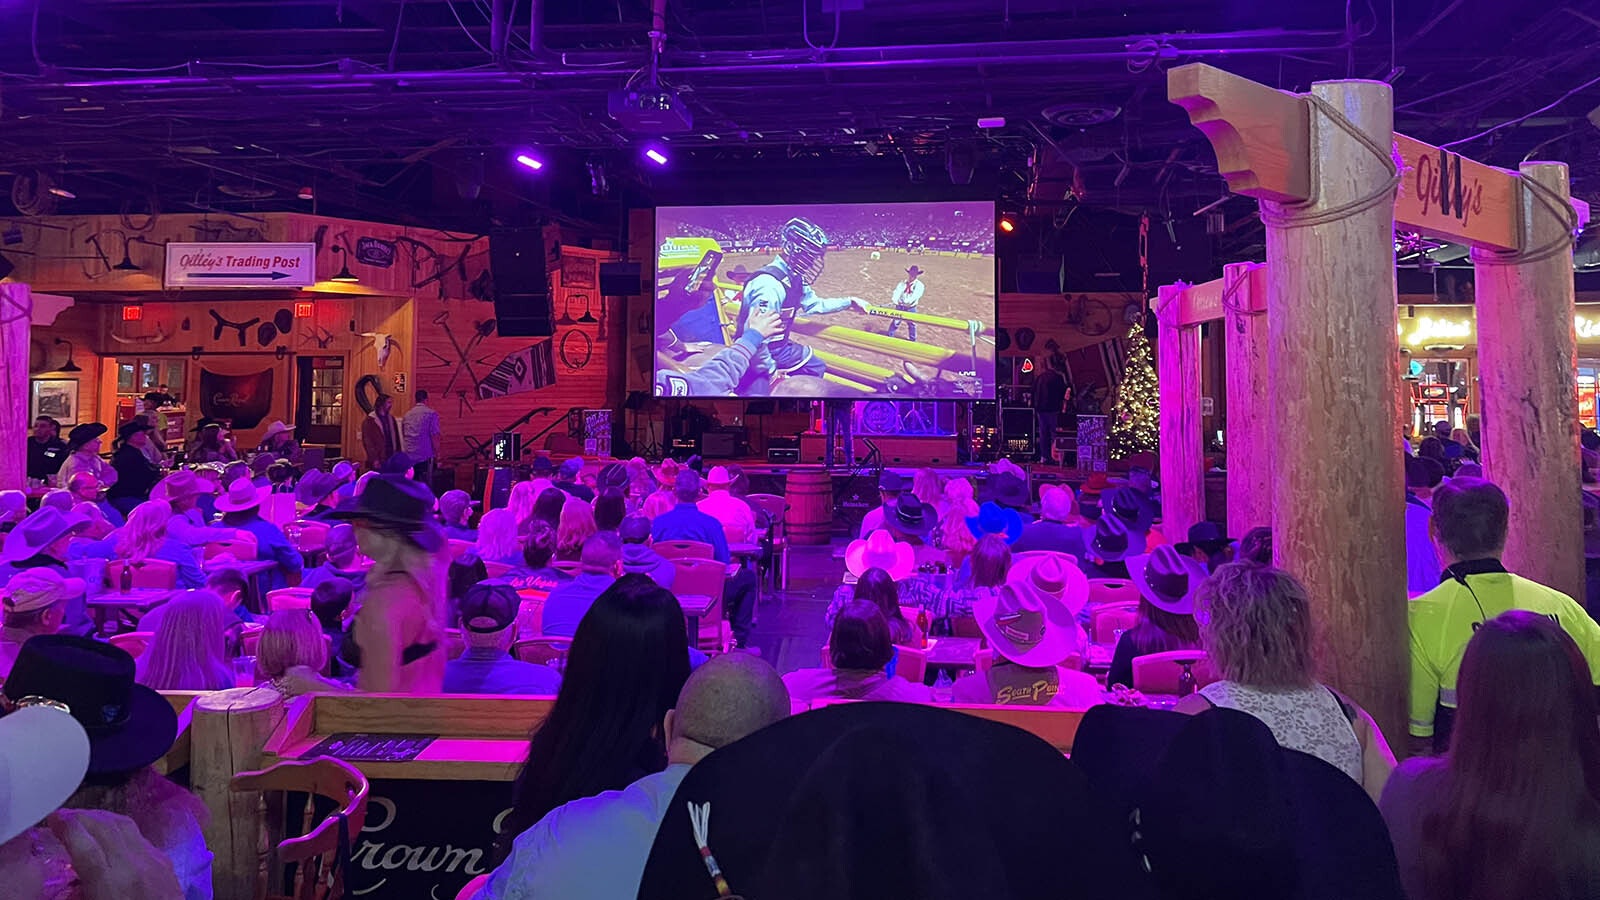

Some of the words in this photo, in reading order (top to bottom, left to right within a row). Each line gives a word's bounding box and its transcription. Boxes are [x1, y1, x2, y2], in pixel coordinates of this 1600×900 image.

[180, 250, 223, 270] Gilley's
[226, 255, 270, 269] Trading
[272, 256, 300, 268] Post
[299, 304, 311, 316] EXIT
